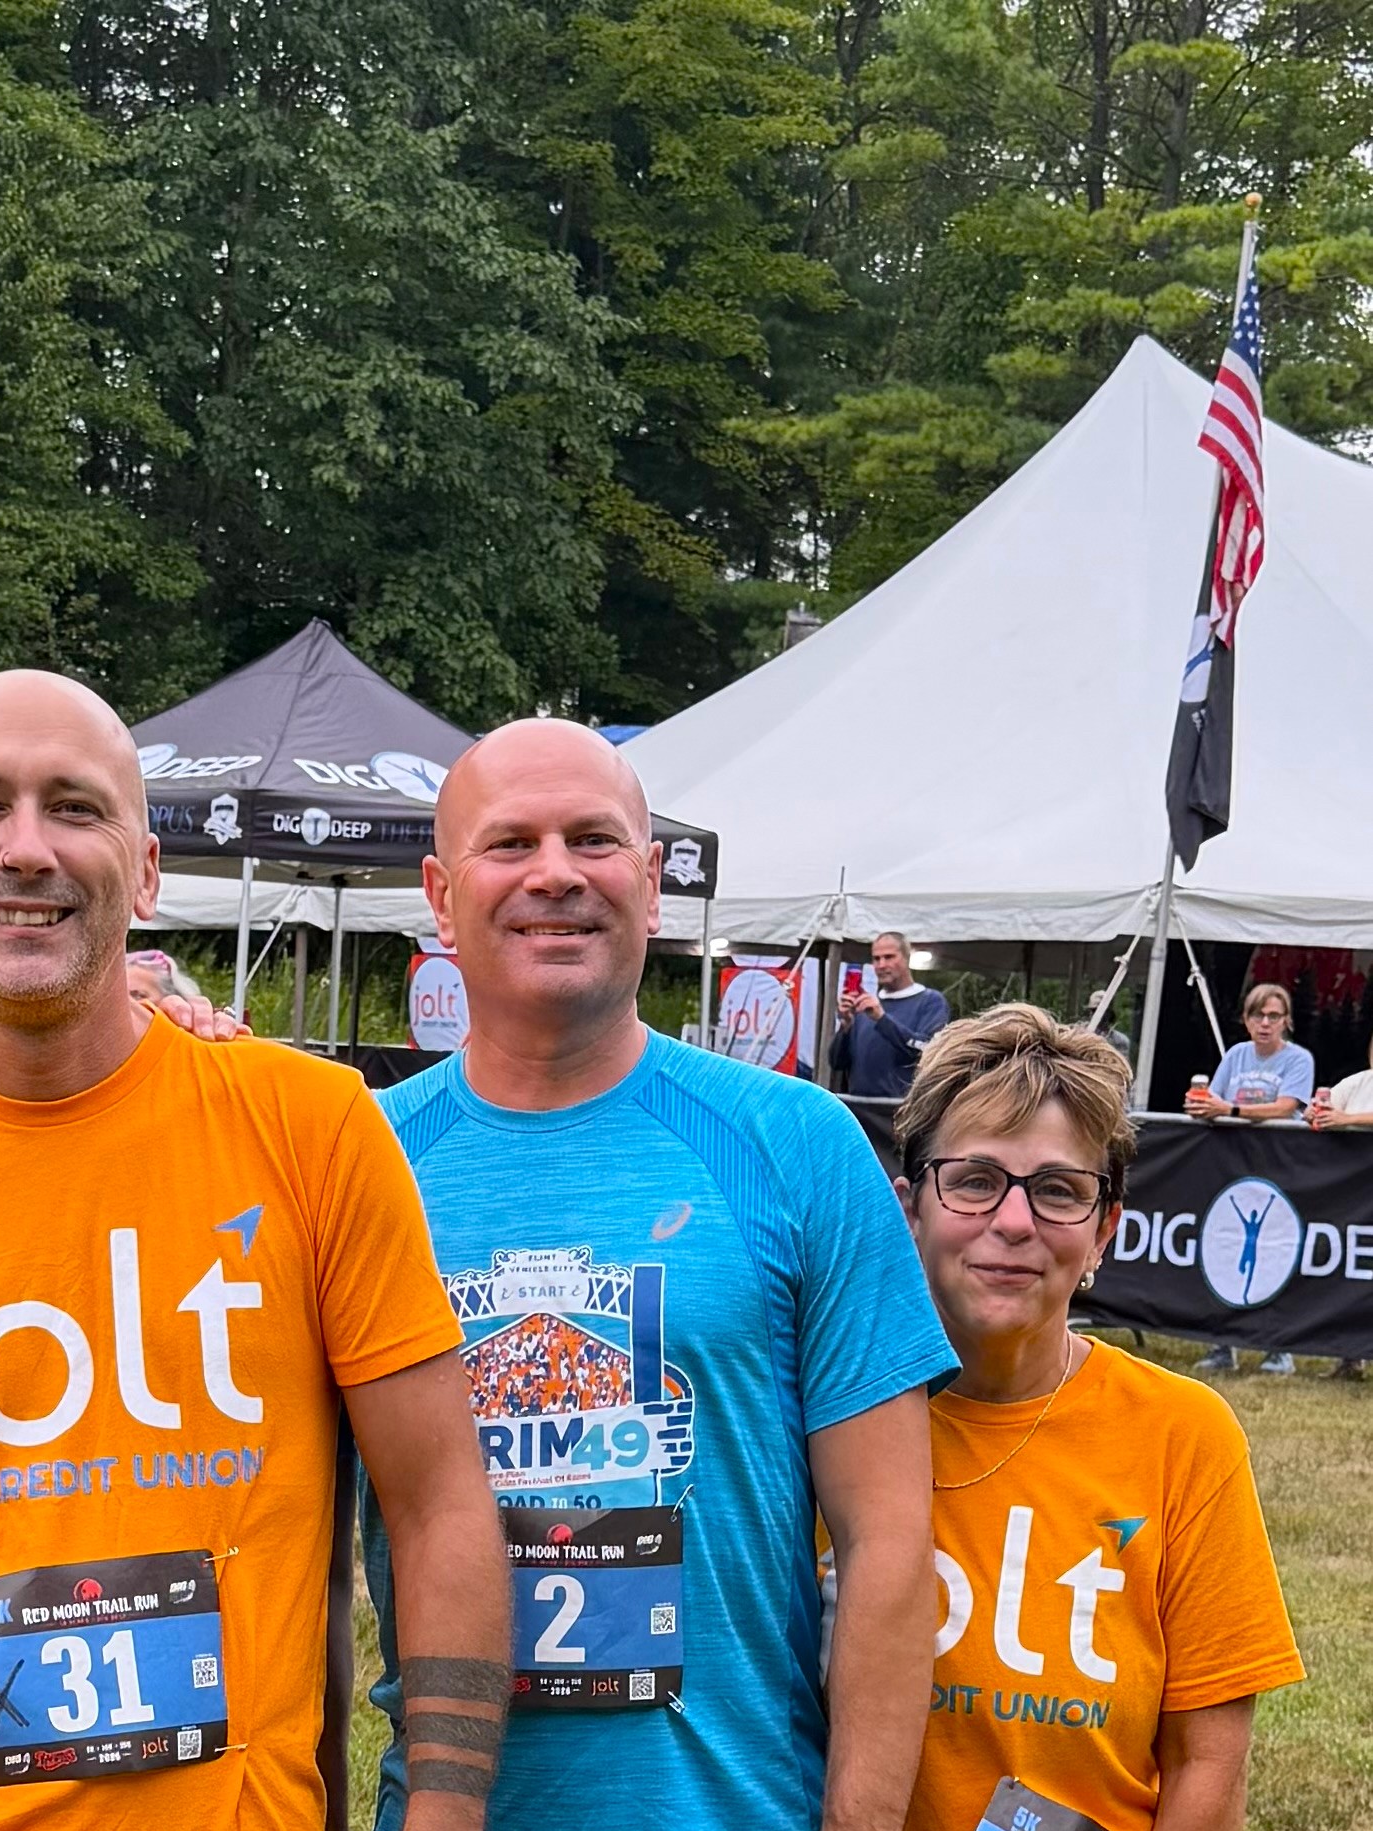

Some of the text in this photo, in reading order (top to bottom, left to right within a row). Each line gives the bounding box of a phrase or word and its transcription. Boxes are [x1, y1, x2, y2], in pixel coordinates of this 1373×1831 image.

[142, 755, 262, 780] DEEP
[292, 757, 390, 791] DIG
[273, 813, 301, 834] DIG
[330, 820, 371, 840] DEEP
[413, 984, 457, 1026] jolt
[1113, 1209, 1197, 1267] DIG
[518, 1285, 567, 1298] START
[133, 1446, 265, 1489] UNION
[526, 1545, 560, 1560] MOON
[563, 1544, 598, 1559] TRAIL
[601, 1544, 625, 1559] RUN
[21, 1607, 50, 1625] RED
[52, 1602, 91, 1621] MOON
[92, 1597, 132, 1616] TRAIL
[134, 1593, 160, 1611] RUN
[534, 1574, 586, 1663] 2
[40, 1629, 155, 1734] 31
[993, 1691, 1110, 1728] UNION
